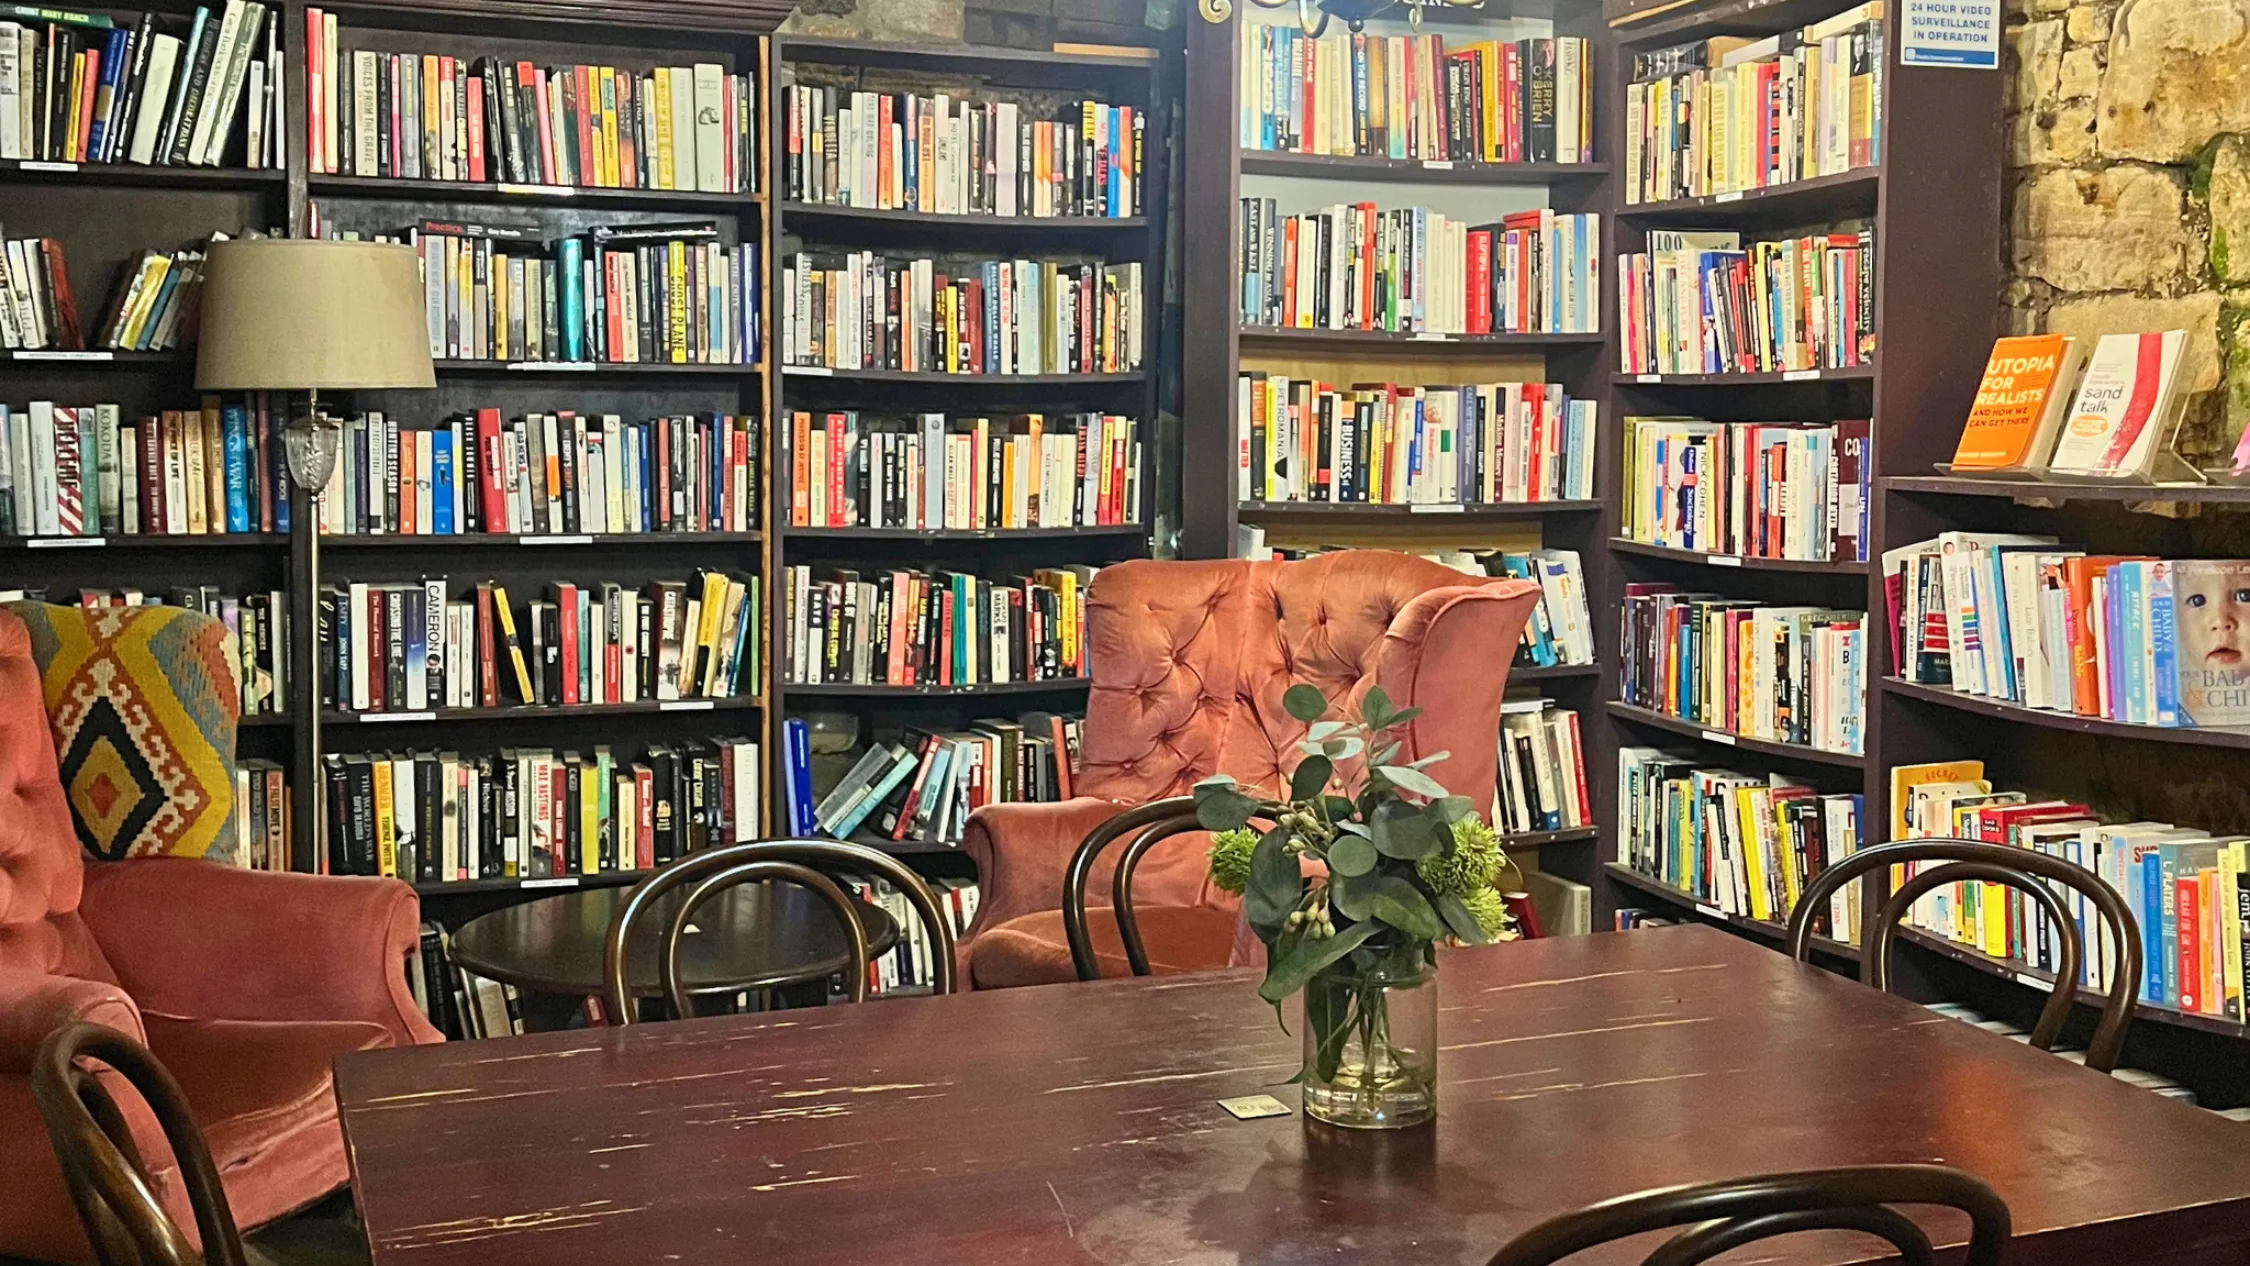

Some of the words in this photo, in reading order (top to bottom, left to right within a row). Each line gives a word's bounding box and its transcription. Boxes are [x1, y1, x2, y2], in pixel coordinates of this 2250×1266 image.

[1911, 3, 1923, 11] 24
[1927, 4, 1956, 13] HOUR
[1960, 6, 1991, 15] VIDEO
[1912, 17, 1990, 29] SURVEILLANCE
[1914, 31, 1924, 39] IN
[1928, 32, 1987, 42] OPERATION
[1358, 52, 1366, 63] ON
[193, 66, 204, 86] AND
[363, 56, 375, 87] VOICES
[1358, 65, 1366, 78] THE
[364, 91, 376, 115] FROM
[1358, 80, 1367, 111] RECORD
[1463, 87, 1471, 104] KING
[1533, 65, 1542, 122] O'BRIEN
[1543, 69, 1552, 118] KERRY
[180, 88, 201, 148] DECORATIONS
[364, 116, 376, 133] THE
[364, 136, 377, 163] GRAVE
[1249, 201, 1258, 225] EAST
[1265, 227, 1274, 271] WINNING
[1656, 233, 1682, 251] 100
[1249, 243, 1257, 270] WEST
[1862, 247, 1871, 283] escape
[671, 276, 684, 311] GHOST
[991, 265, 999, 297] BILLION
[1264, 282, 1272, 302] ASIA
[991, 300, 999, 330] DOLLAR
[1862, 286, 1872, 332] velocity
[672, 316, 684, 352] PLANE
[991, 333, 999, 360] WHALE
[1988, 354, 2053, 374] UTOPIA
[1982, 377, 2014, 390] FOR
[2084, 386, 2123, 399] sand
[1976, 389, 2044, 405] REALISTS
[2080, 400, 2108, 413] talk
[1277, 388, 1285, 458] PETROMANIA
[1969, 420, 1986, 428] CAN
[1988, 419, 2005, 427] GET
[2006, 417, 2030, 426] THERE
[1973, 409, 1990, 417] AND
[1992, 408, 2013, 417] HOW
[2015, 407, 2028, 415] WE
[100, 409, 112, 459] KOKODA
[387, 421, 397, 459] HUNTING
[1495, 414, 1504, 446] Making
[171, 452, 179, 461] OF
[518, 445, 527, 464] NEWS
[563, 440, 572, 466] ENEMY'S
[1341, 425, 1353, 479] BUSINESS
[1494, 448, 1503, 475] Money
[1699, 452, 1707, 477] NICK
[171, 464, 179, 478] LIFE
[230, 462, 241, 489] WAR
[388, 461, 398, 493] SEASON
[564, 468, 573, 488] ENEMY
[1684, 488, 1694, 535] Sociology
[1699, 480, 1707, 517] COHEN
[428, 586, 440, 651] CAMERON
[2024, 607, 2035, 626] Late
[2131, 591, 2140, 629] ATTACK
[390, 628, 401, 641] THE
[2152, 608, 2163, 651] CHILD
[2161, 608, 2172, 641] BABY
[2203, 669, 2246, 687] BAB
[2207, 690, 2249, 707] CHI
[361, 775, 370, 795] THE
[538, 765, 548, 781] MAX
[538, 784, 549, 820] HASTINGS
[2164, 872, 2174, 916] PLATERS
